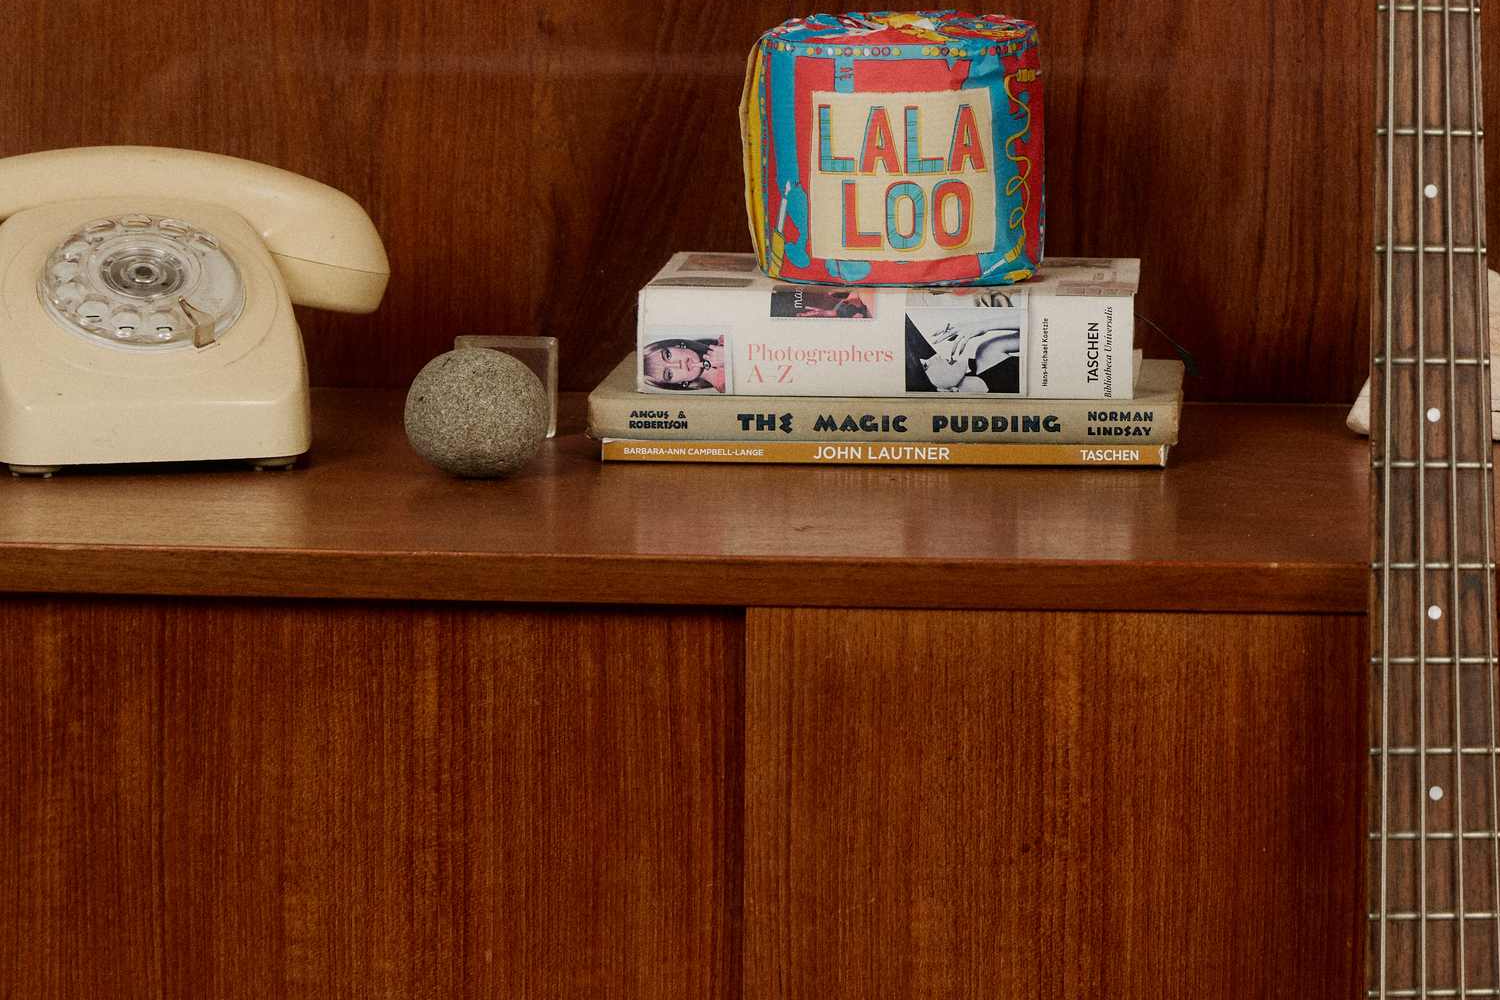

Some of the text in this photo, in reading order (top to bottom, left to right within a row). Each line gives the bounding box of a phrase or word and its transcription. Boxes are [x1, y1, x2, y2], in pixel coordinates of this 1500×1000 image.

[817, 103, 988, 176] LALA
[841, 178, 974, 252] LOO
[747, 343, 894, 366] Photographers
[1041, 317, 1049, 387] Hans-Michael Koetzle
[1087, 322, 1099, 384] TASCHEN
[1103, 305, 1113, 398] Bibliotheca Universalis
[629, 410, 687, 420] ANGUS &
[737, 412, 1062, 434] THE MAGIC PUDDING
[1087, 411, 1154, 422] NORMAN
[628, 420, 688, 430] ROBERTSON
[1087, 426, 1152, 437] LINDSAY
[623, 447, 764, 457] BARBARA-ANN CAMPBELL-LANGE
[813, 446, 950, 461] JOHN LAUTNER
[1079, 449, 1140, 462] TASCHEN
